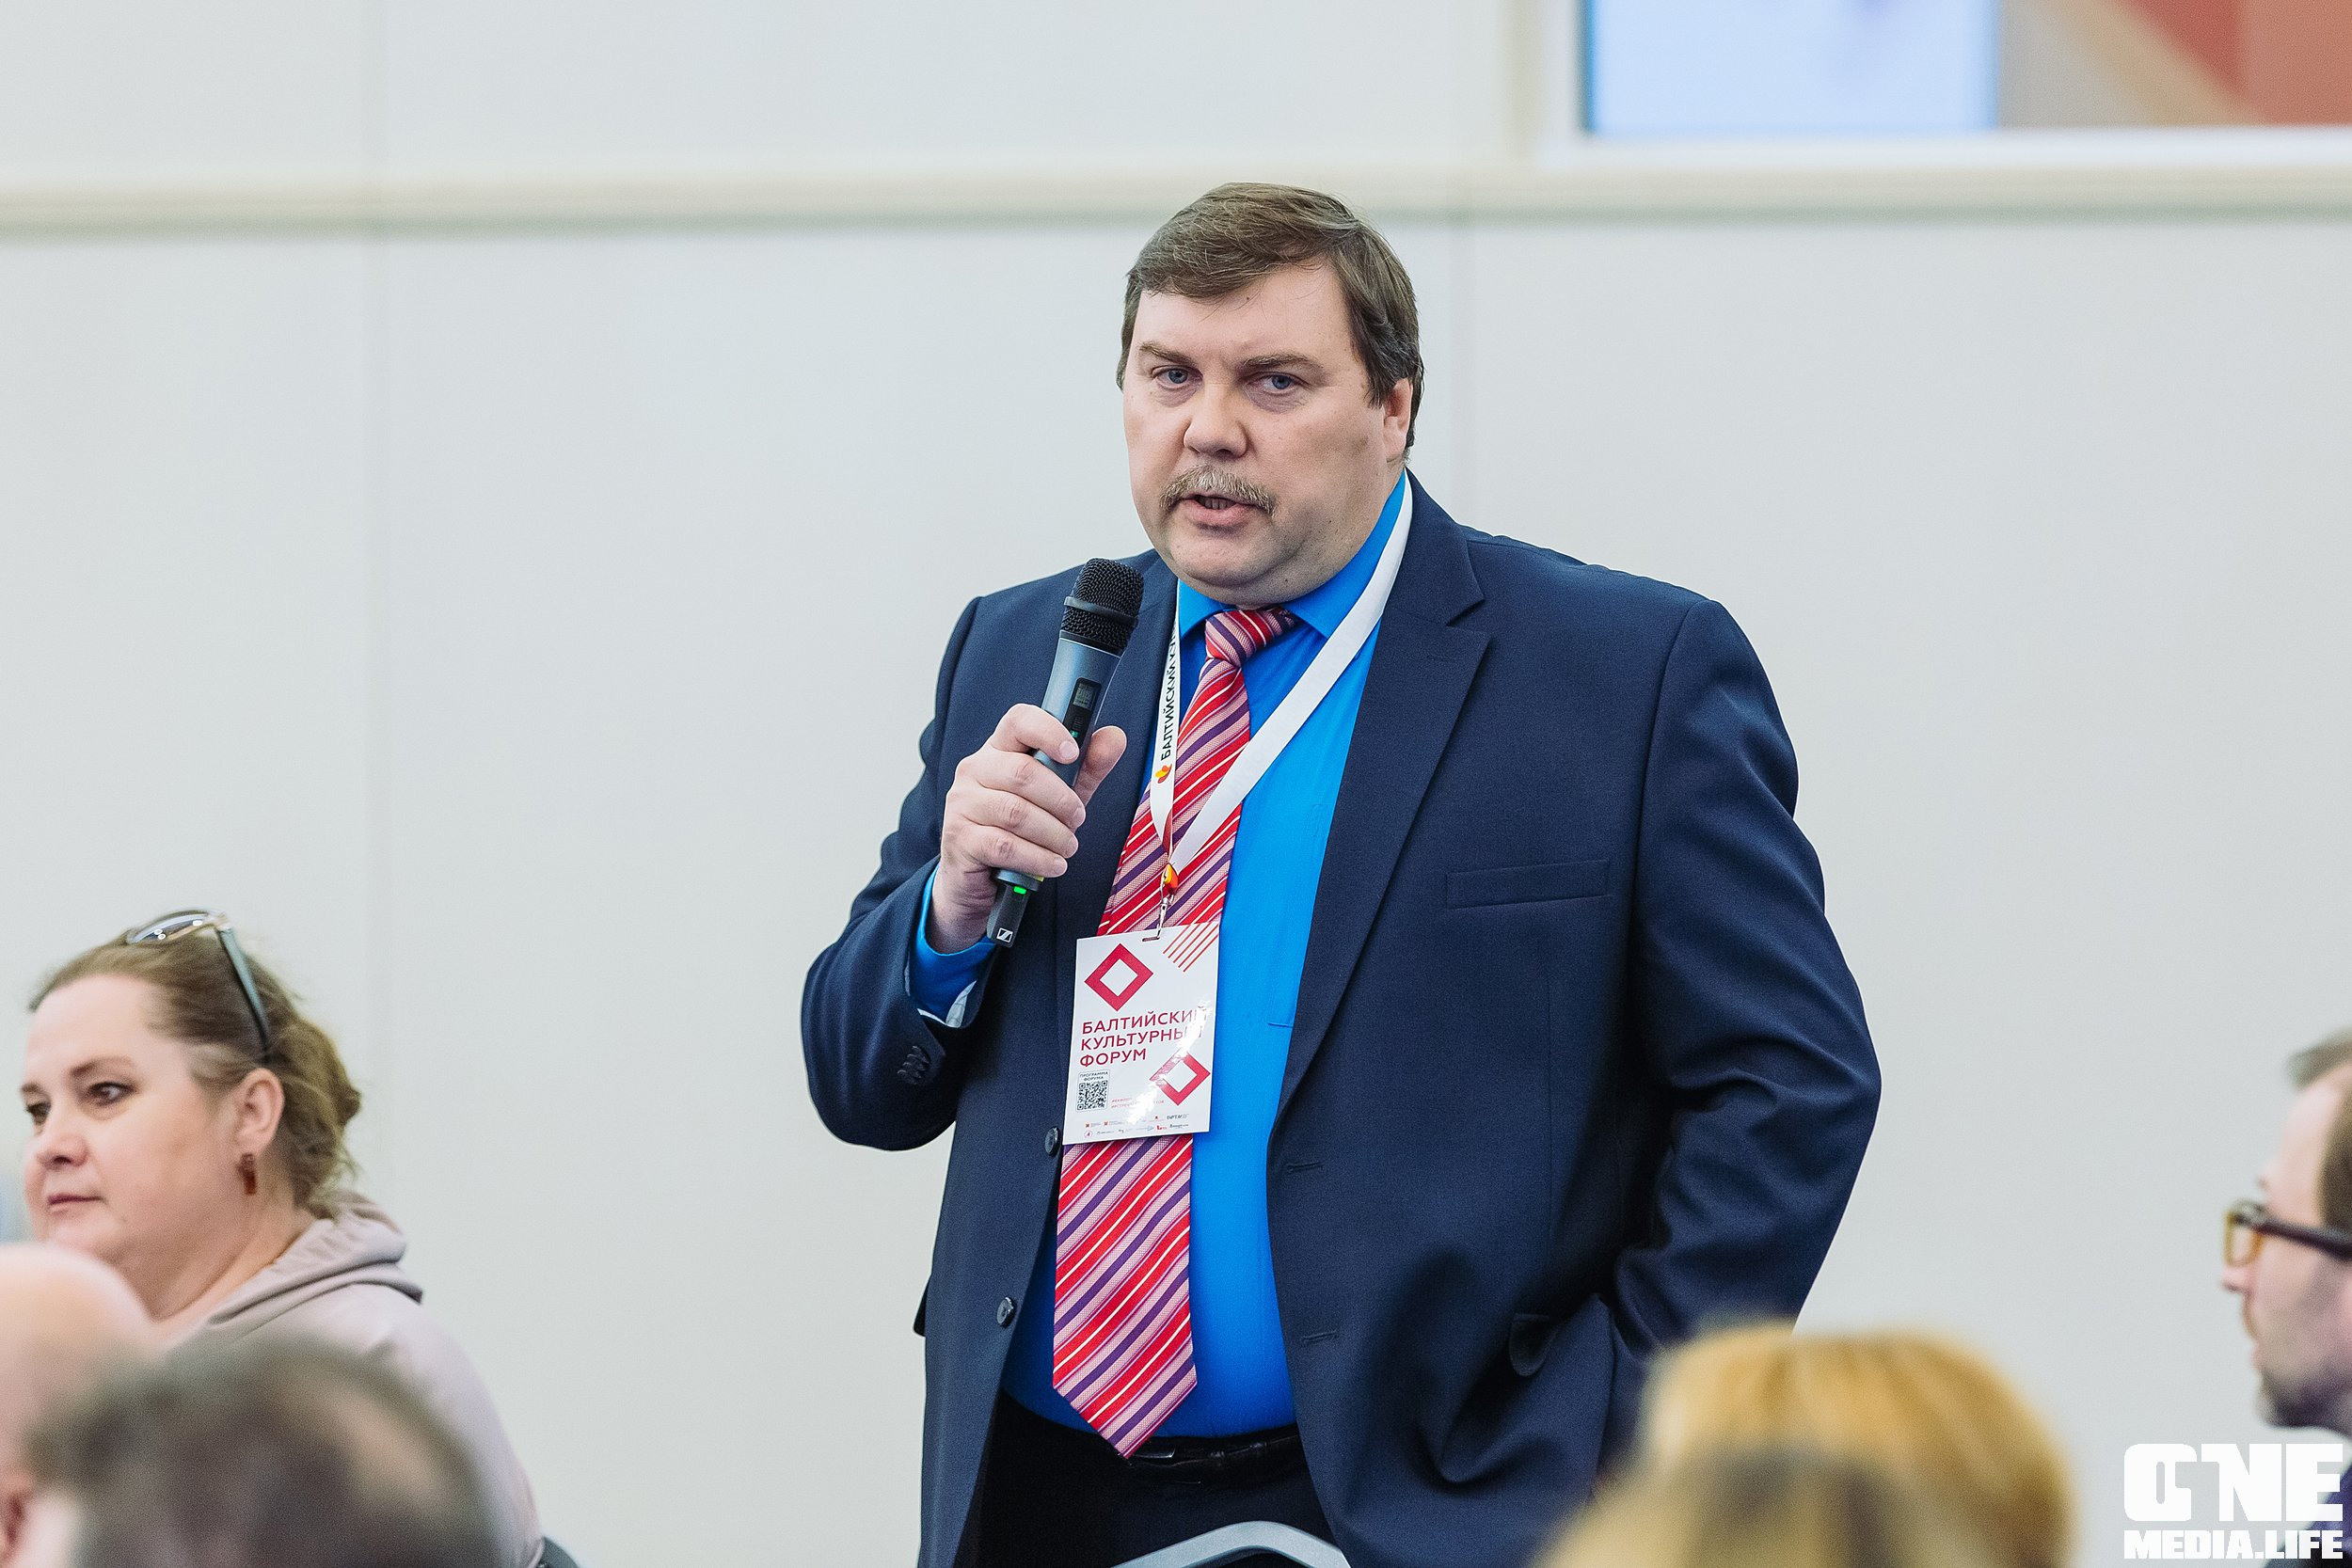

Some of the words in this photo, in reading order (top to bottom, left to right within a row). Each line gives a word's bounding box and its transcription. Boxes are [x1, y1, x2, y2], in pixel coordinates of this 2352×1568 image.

[1161, 662, 1175, 761] БАЛТИЙСКИЙ
[1080, 1025, 1202, 1052] КУЛЬТУРНЫ
[1079, 1048, 1147, 1068] ФОРУМ
